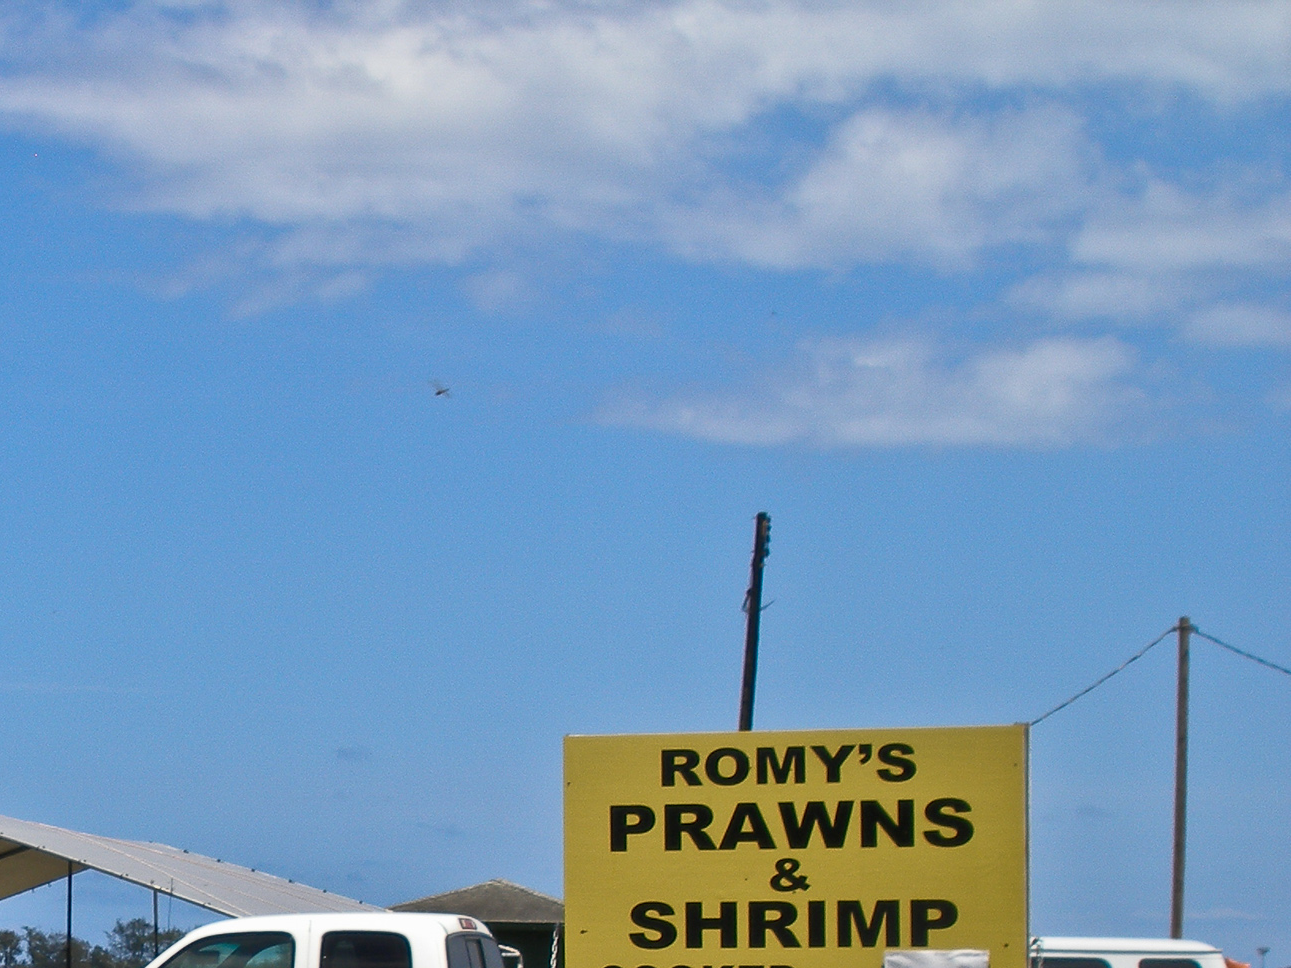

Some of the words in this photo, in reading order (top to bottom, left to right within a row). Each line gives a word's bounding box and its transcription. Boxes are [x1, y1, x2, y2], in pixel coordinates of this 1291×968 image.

[661, 743, 917, 787] ROMY'S
[610, 798, 975, 852] PRAWNS
[769, 858, 811, 892] &
[629, 899, 959, 949] SHRIMP
